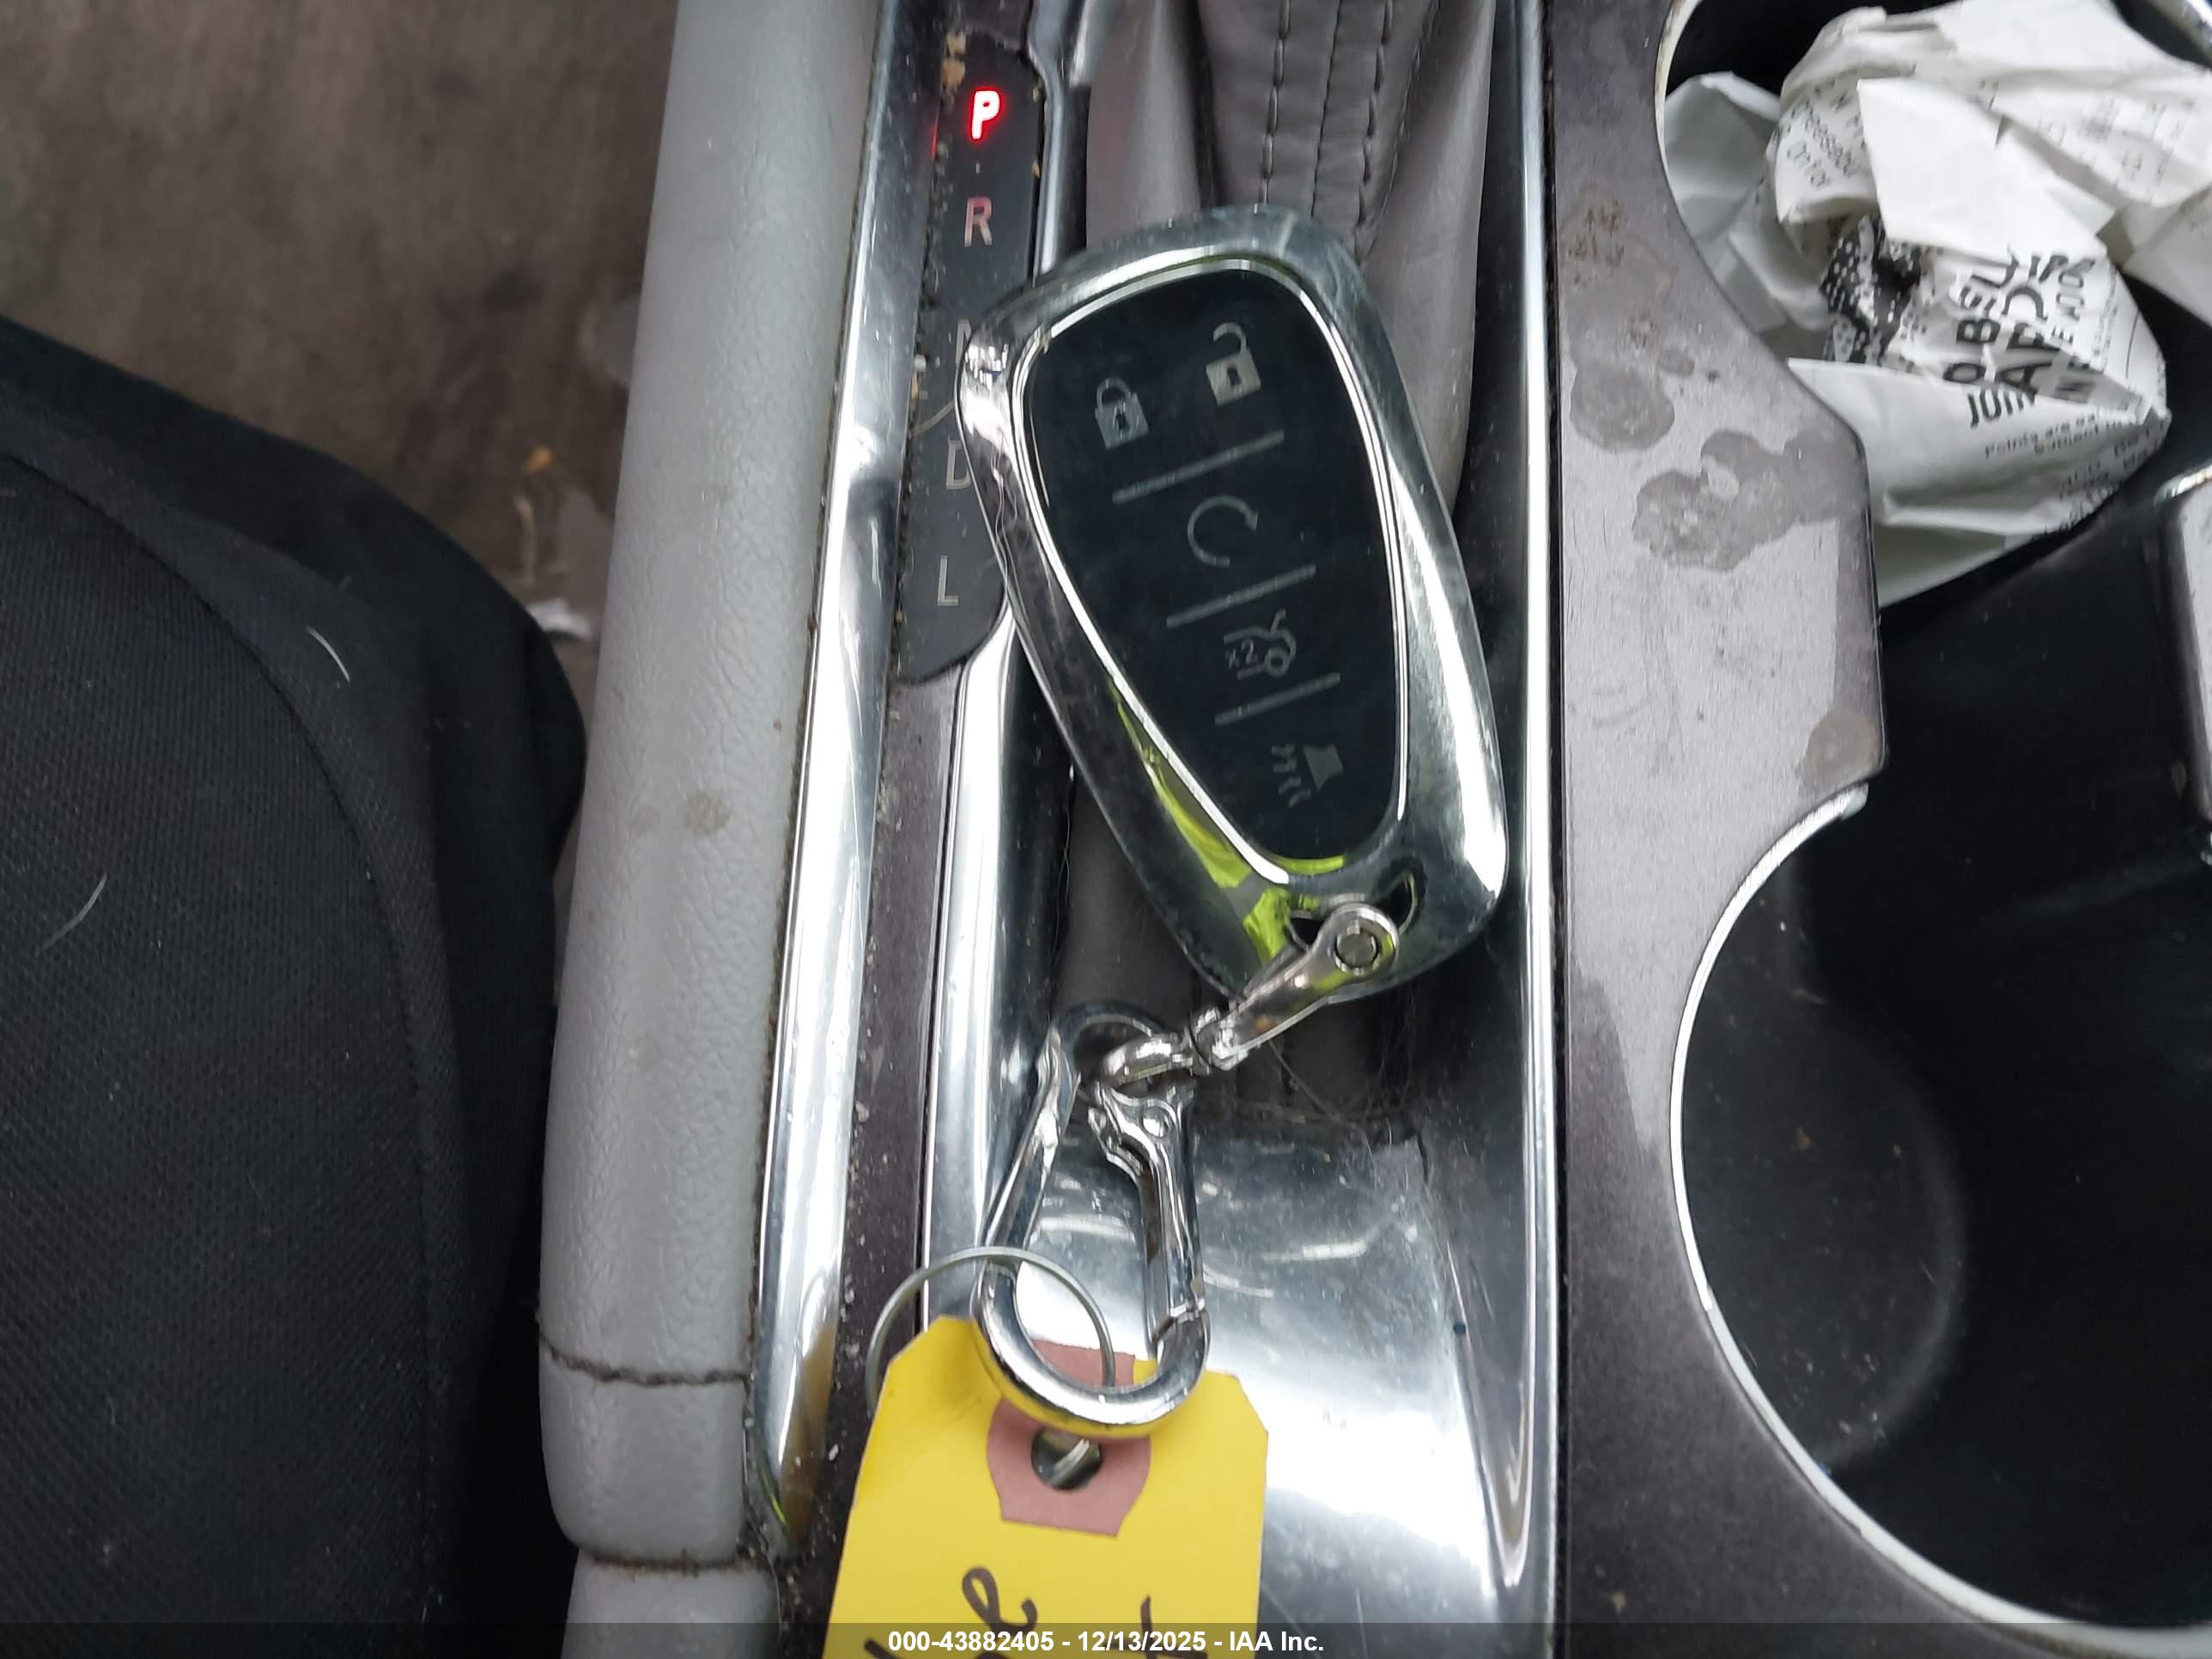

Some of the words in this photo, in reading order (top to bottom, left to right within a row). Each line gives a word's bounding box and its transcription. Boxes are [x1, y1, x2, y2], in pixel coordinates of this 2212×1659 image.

[971, 89, 1000, 140] P
[964, 197, 993, 247] R
[945, 440, 971, 490] D
[938, 556, 959, 606] L
